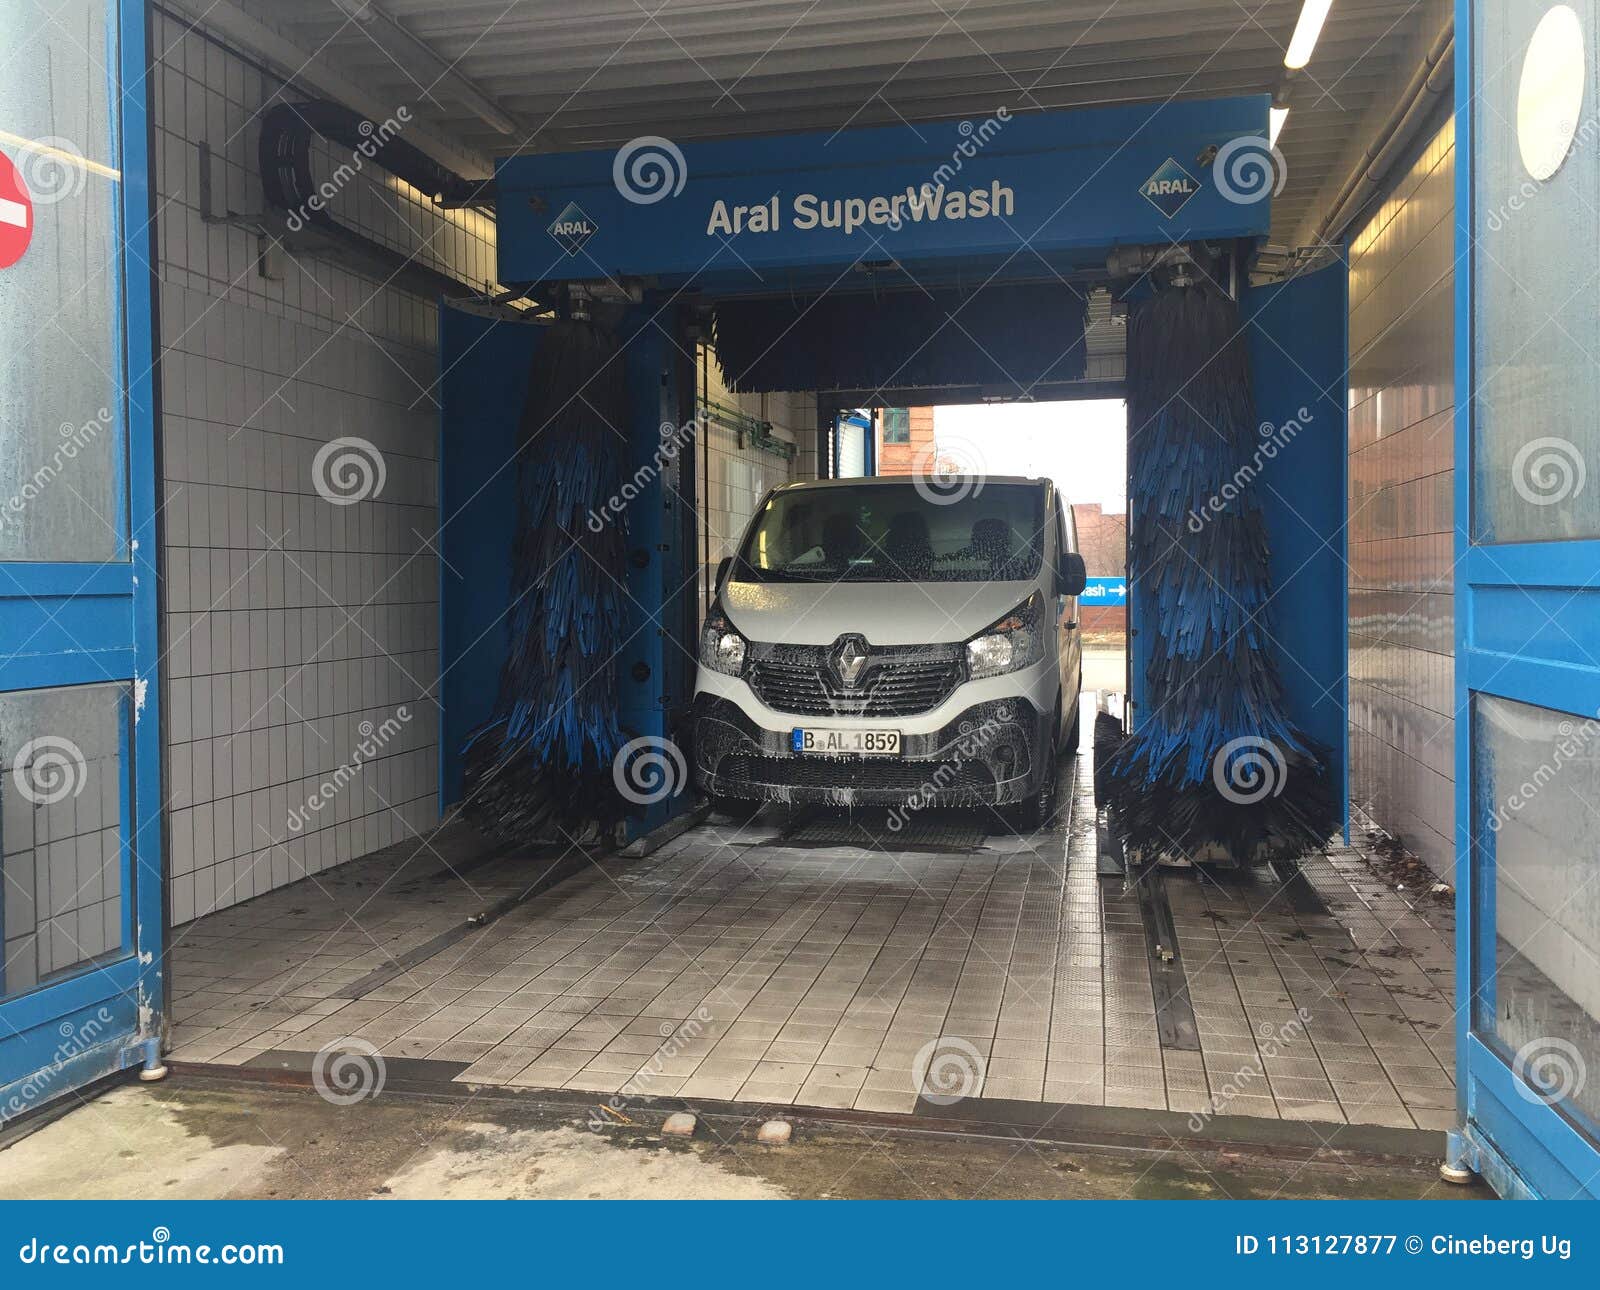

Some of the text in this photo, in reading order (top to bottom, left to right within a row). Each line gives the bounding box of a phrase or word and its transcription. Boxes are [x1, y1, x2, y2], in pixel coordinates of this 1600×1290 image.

[1147, 179, 1193, 196] ARAL
[707, 179, 1014, 236] Aral SuperWash
[553, 221, 591, 235] ARAL
[804, 732, 897, 751] B AL 1859
